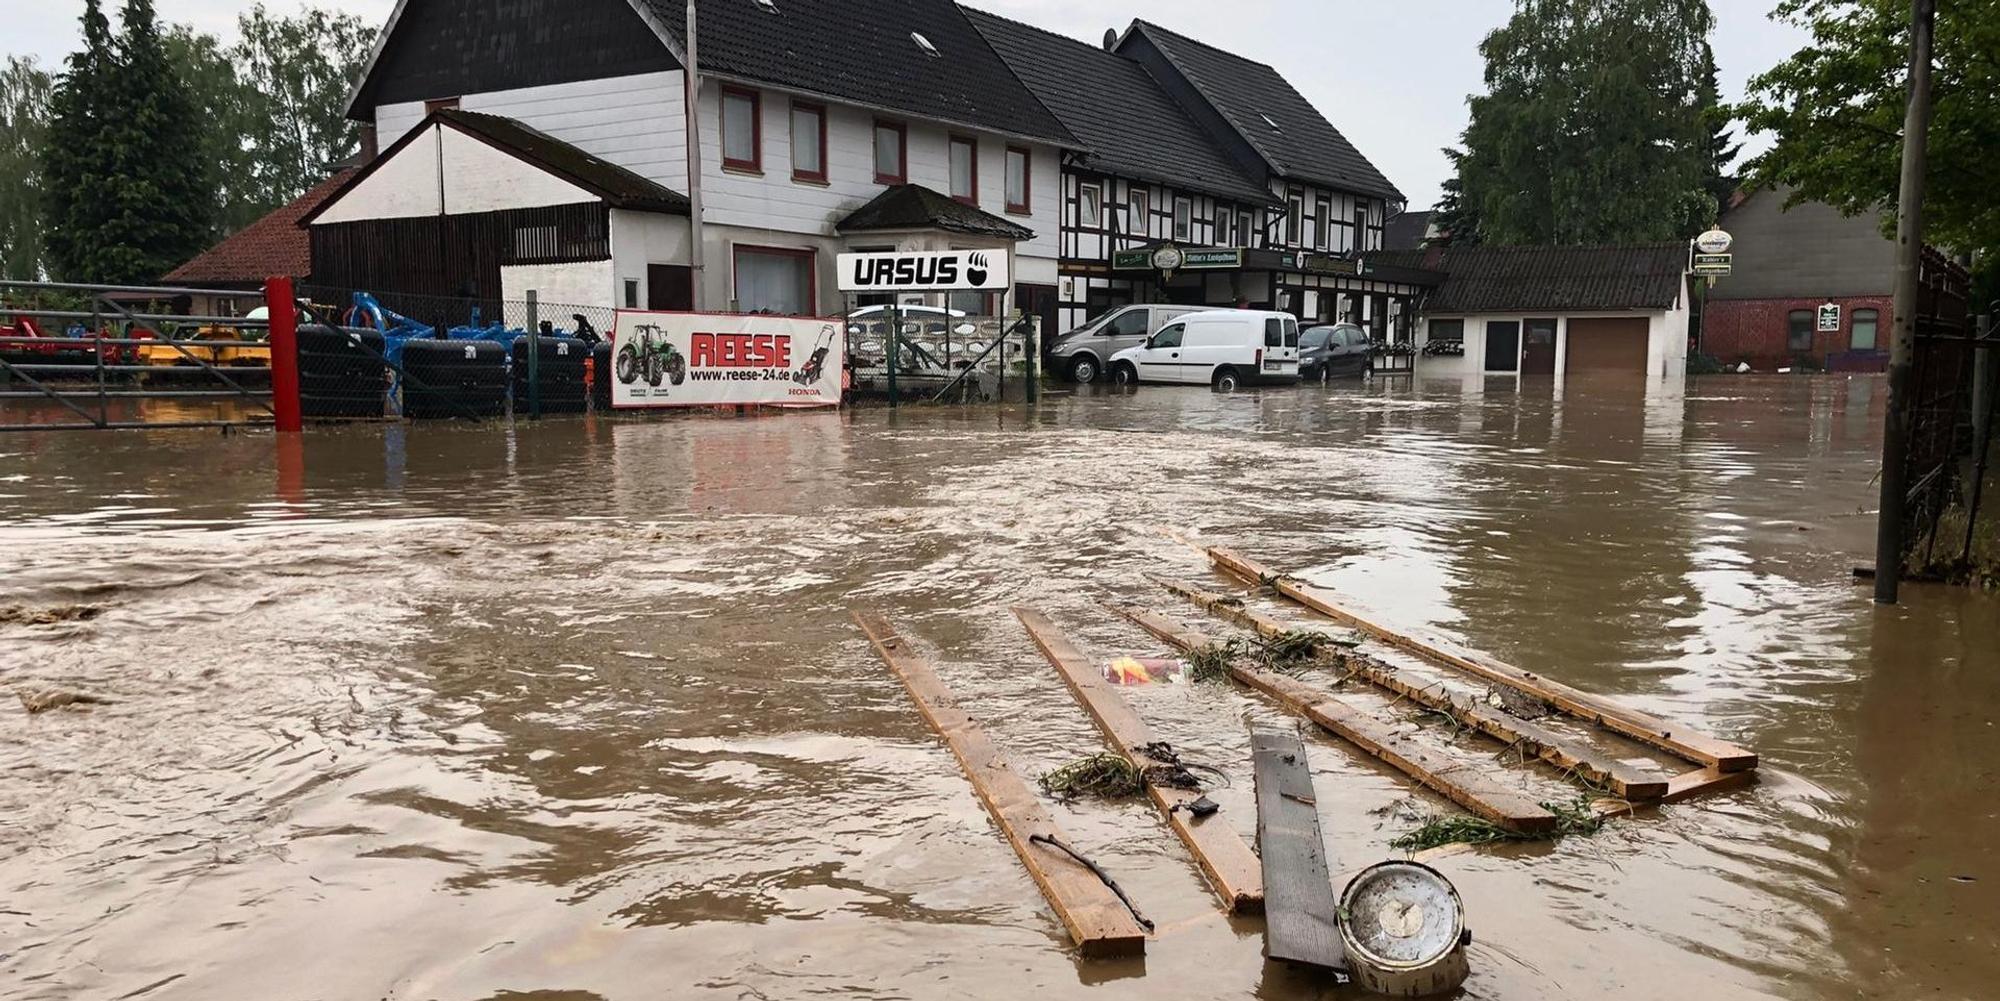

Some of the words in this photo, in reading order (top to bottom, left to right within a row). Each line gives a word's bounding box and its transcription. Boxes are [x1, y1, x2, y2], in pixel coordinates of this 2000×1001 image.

[854, 256, 958, 286] URSUS
[690, 332, 791, 368] REESE
[690, 368, 790, 382] www.reese-24.de
[788, 388, 821, 396] HONDA
